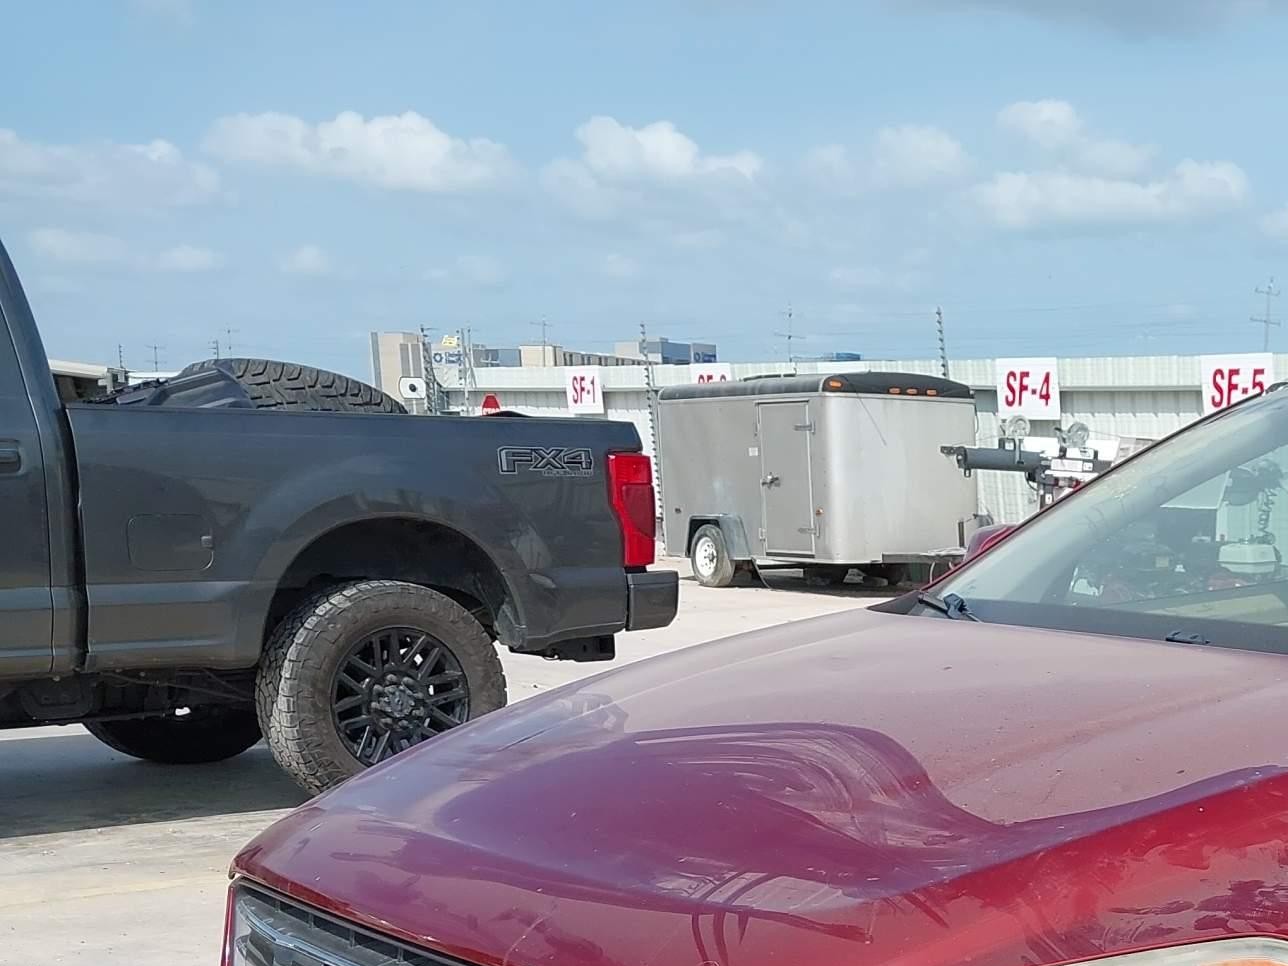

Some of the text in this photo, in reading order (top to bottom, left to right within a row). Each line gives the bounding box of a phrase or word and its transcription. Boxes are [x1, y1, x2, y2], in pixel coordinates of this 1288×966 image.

[572, 375, 596, 404] SF-1
[1004, 370, 1051, 407] SF-4
[1211, 368, 1265, 408] SF-5
[497, 446, 593, 474] FX4
